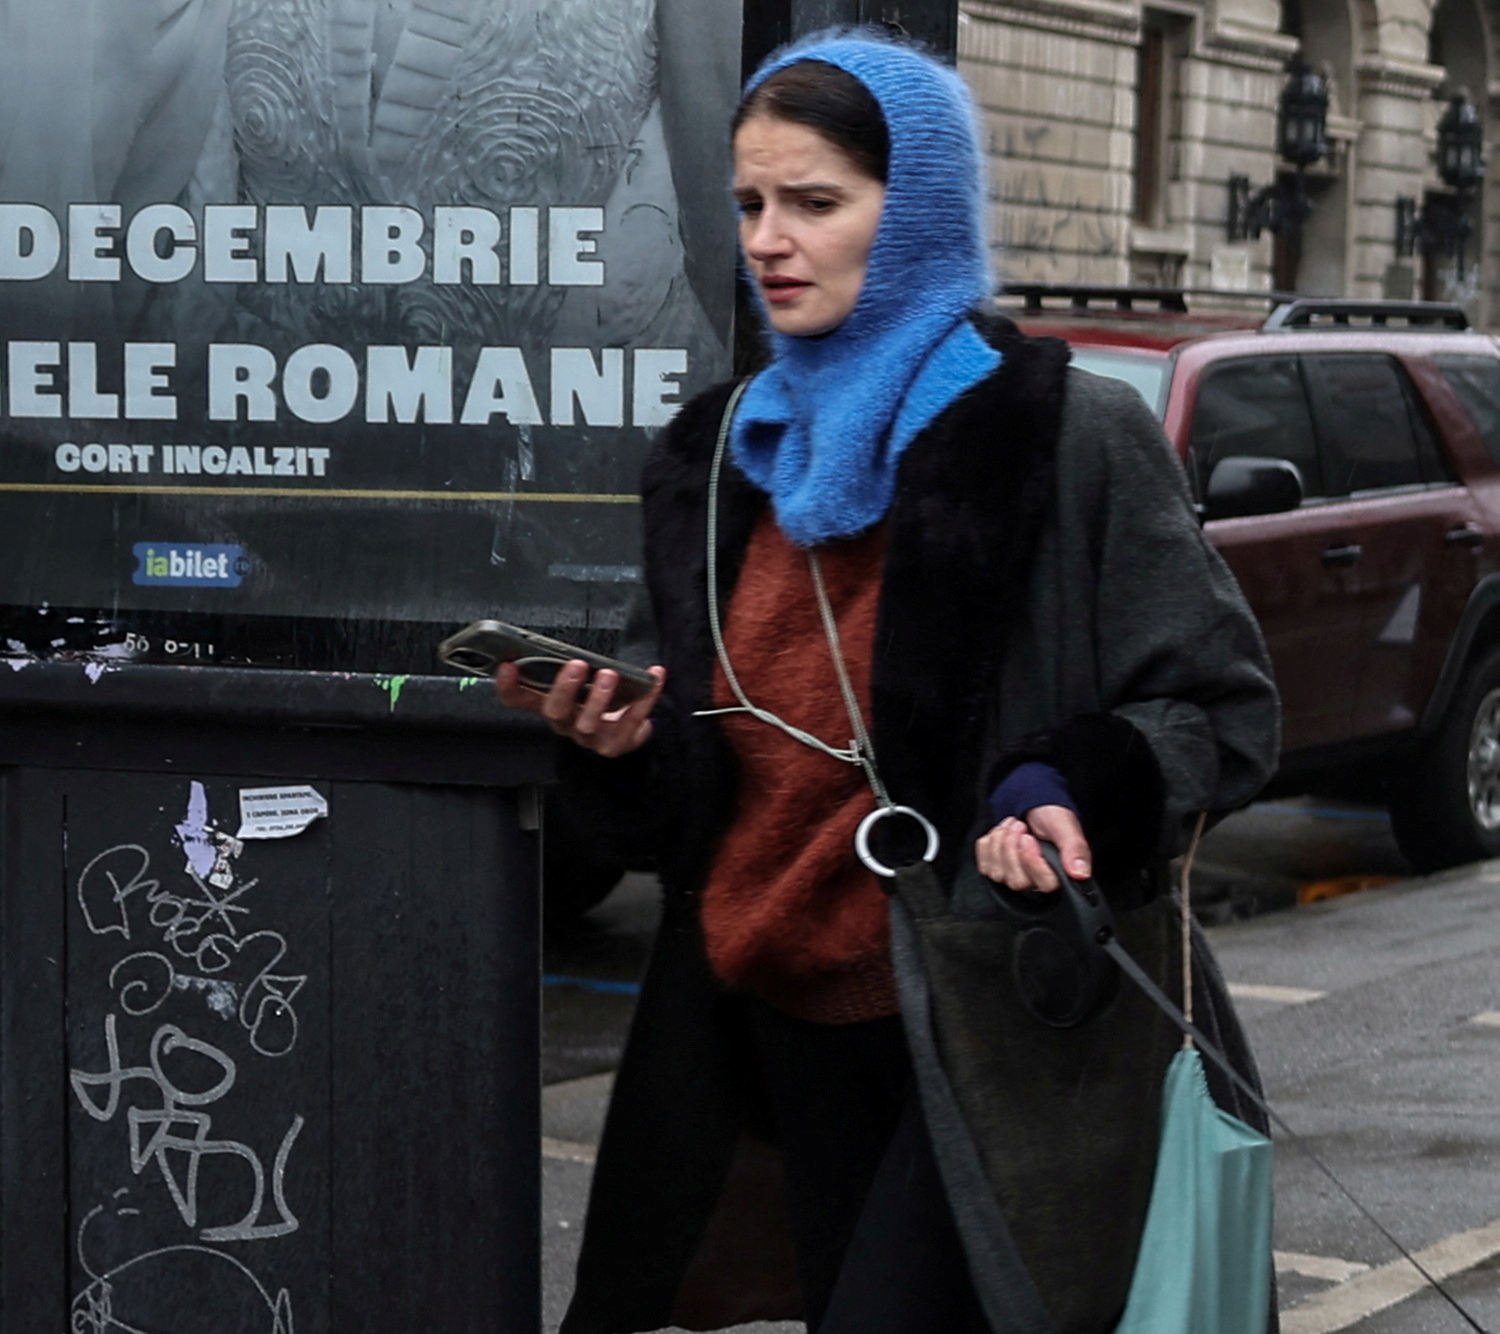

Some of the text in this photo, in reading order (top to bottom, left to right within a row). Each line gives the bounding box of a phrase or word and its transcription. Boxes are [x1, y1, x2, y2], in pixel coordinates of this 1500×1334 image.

[0, 203, 605, 285] DECEMBRIE
[208, 343, 689, 427] ROMANE
[55, 444, 330, 476] CORT INCALZIT
[146, 548, 229, 579] iabilet
